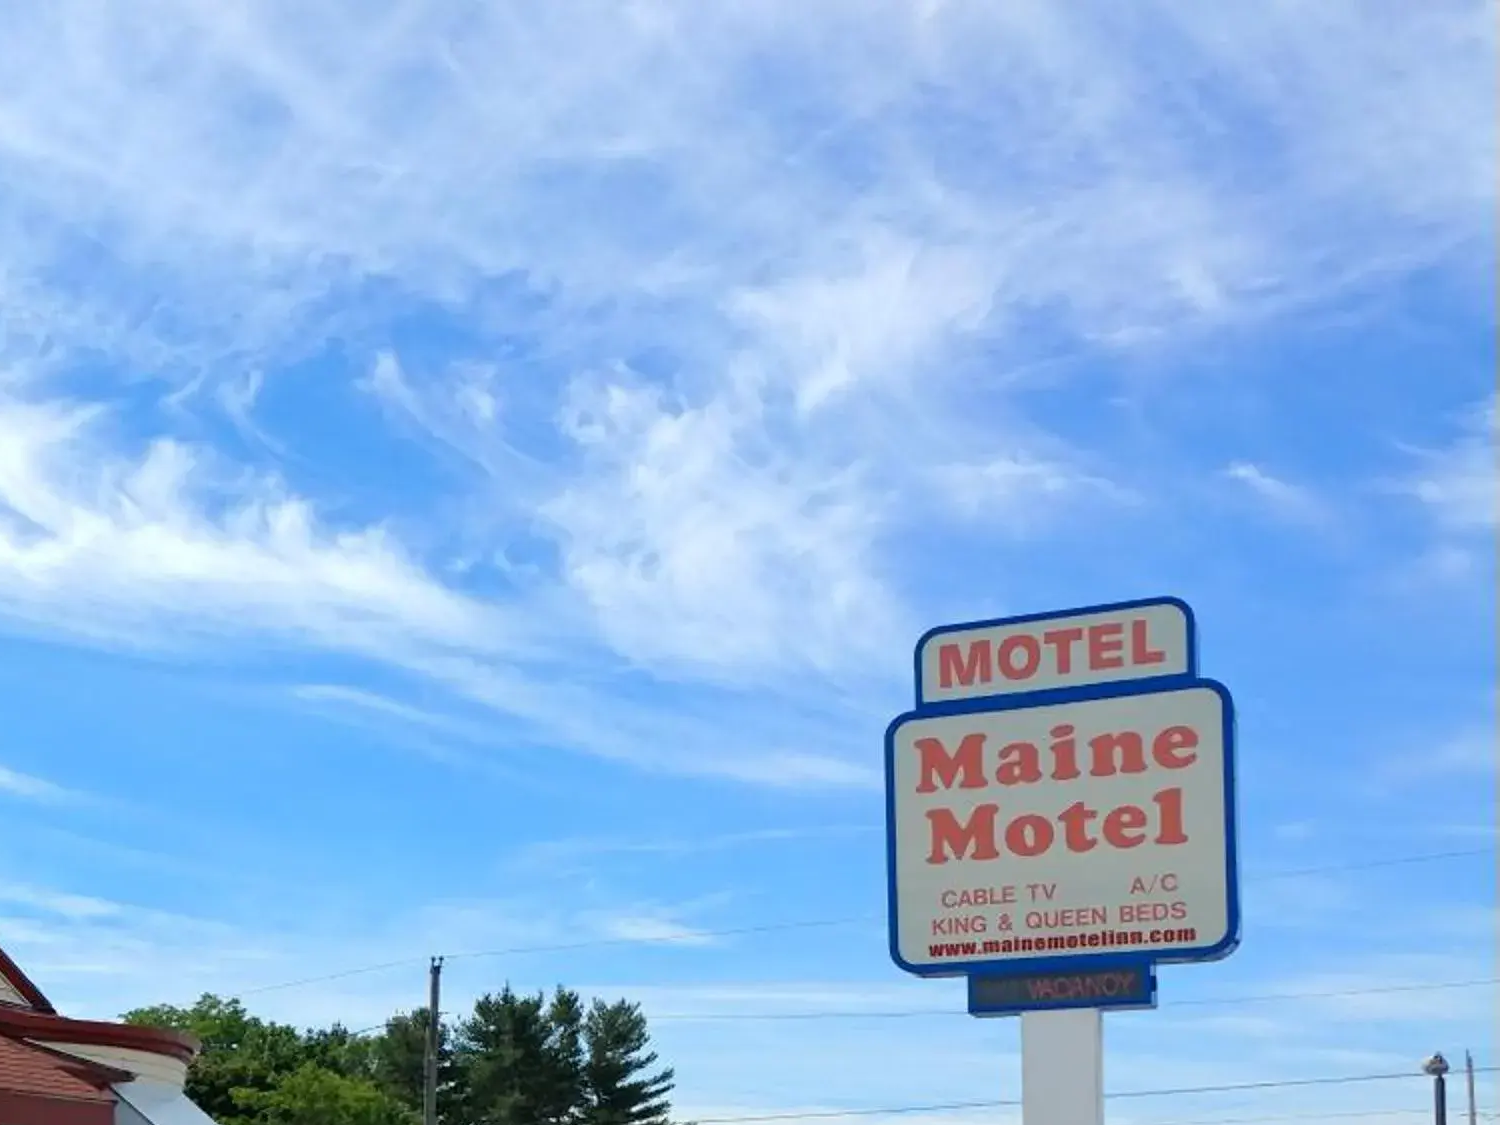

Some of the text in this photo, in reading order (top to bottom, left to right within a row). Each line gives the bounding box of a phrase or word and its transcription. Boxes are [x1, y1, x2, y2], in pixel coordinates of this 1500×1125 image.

[938, 619, 1166, 689] MOTEL
[912, 723, 1200, 795] Maine
[924, 787, 1190, 865] Motel
[940, 873, 1180, 909] CABLE TV A/C
[931, 901, 1188, 936] KING & QUEEN BEDS
[928, 926, 1198, 958] www.mainemotelinn.com
[1026, 972, 1137, 1001] VACANCY
